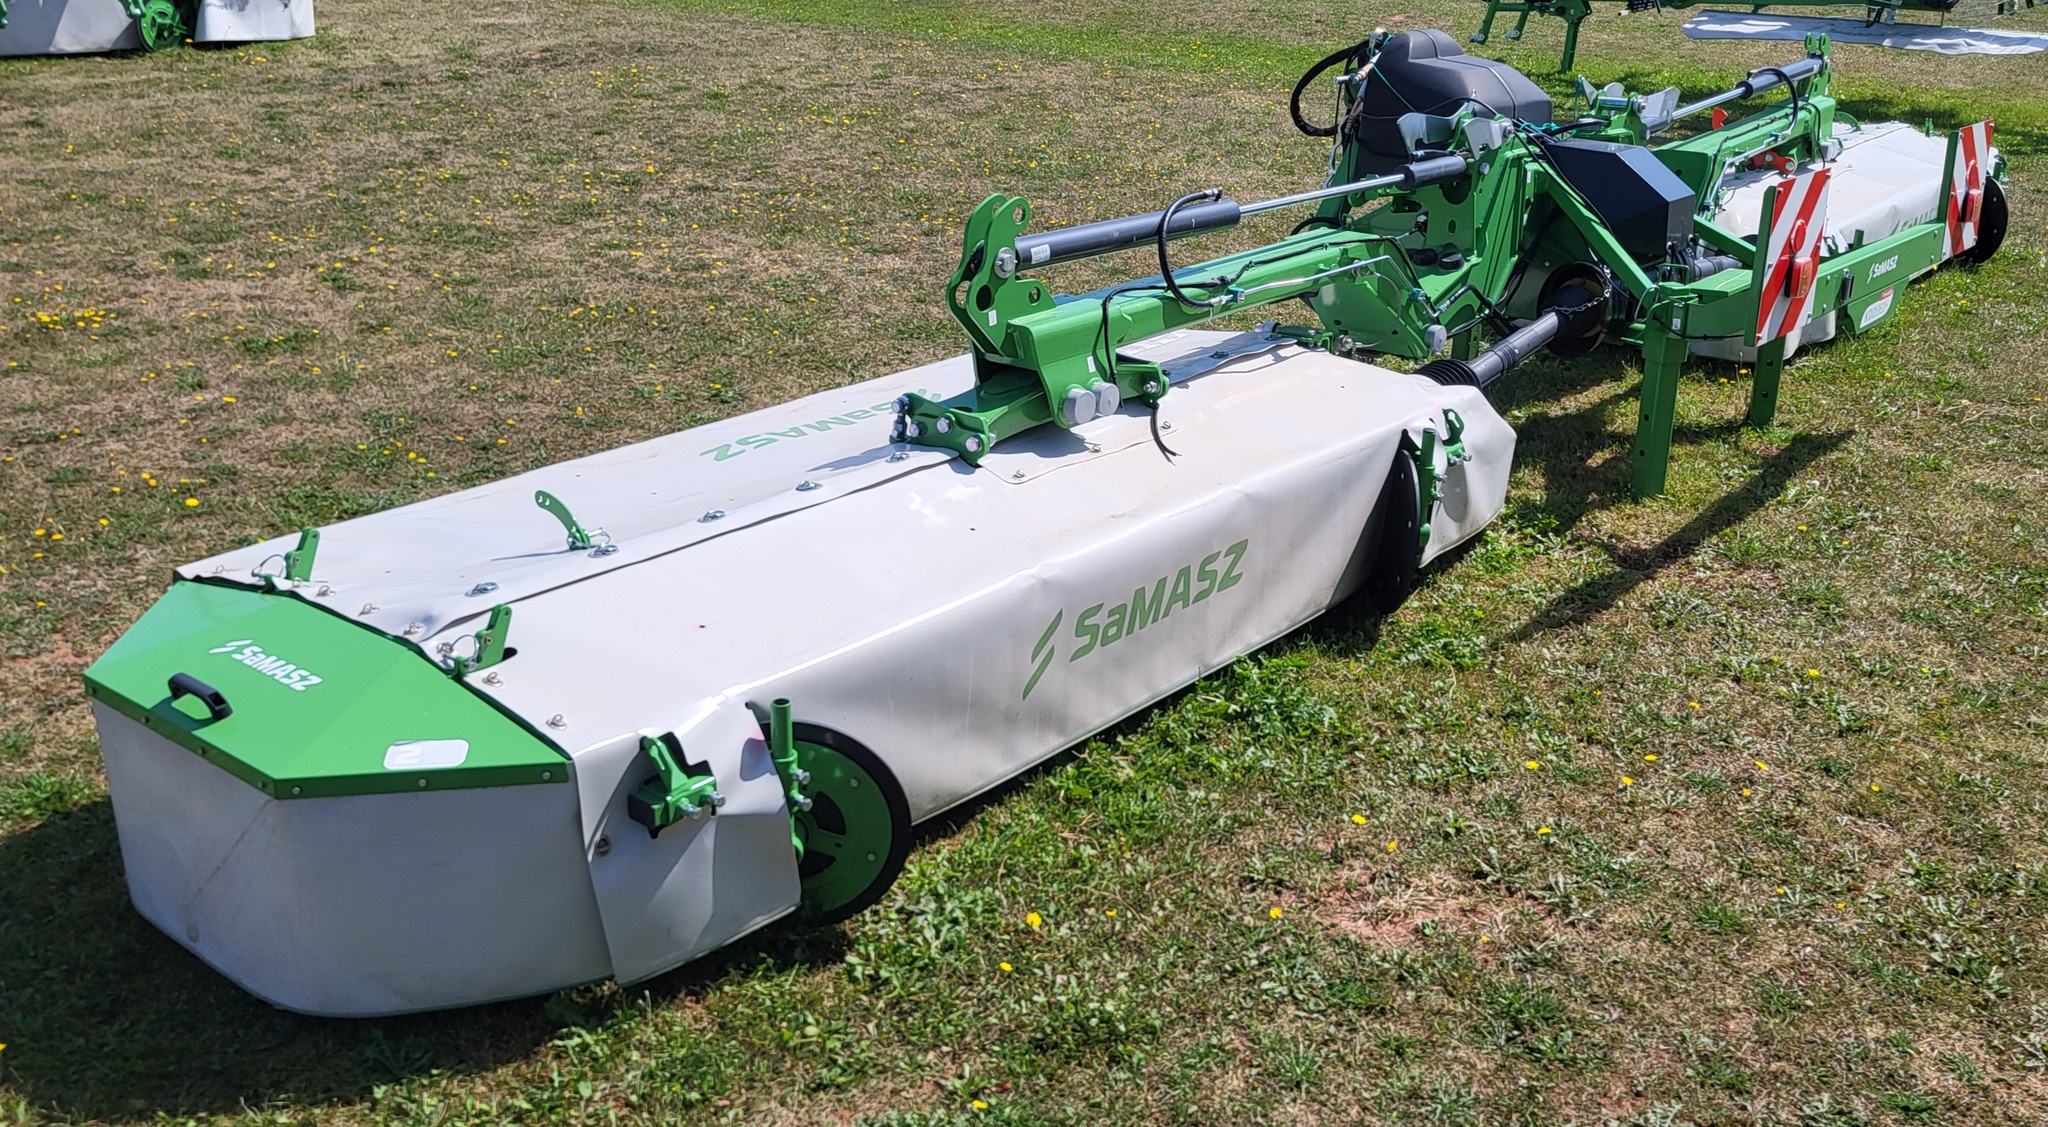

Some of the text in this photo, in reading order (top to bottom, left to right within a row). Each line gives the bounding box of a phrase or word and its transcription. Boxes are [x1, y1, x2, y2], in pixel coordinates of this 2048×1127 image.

[1872, 254, 1899, 279] SaMASZ
[698, 400, 893, 462] SaMASZ
[1069, 538, 1249, 663] SaMASZ
[230, 645, 324, 692] SaMASZ
